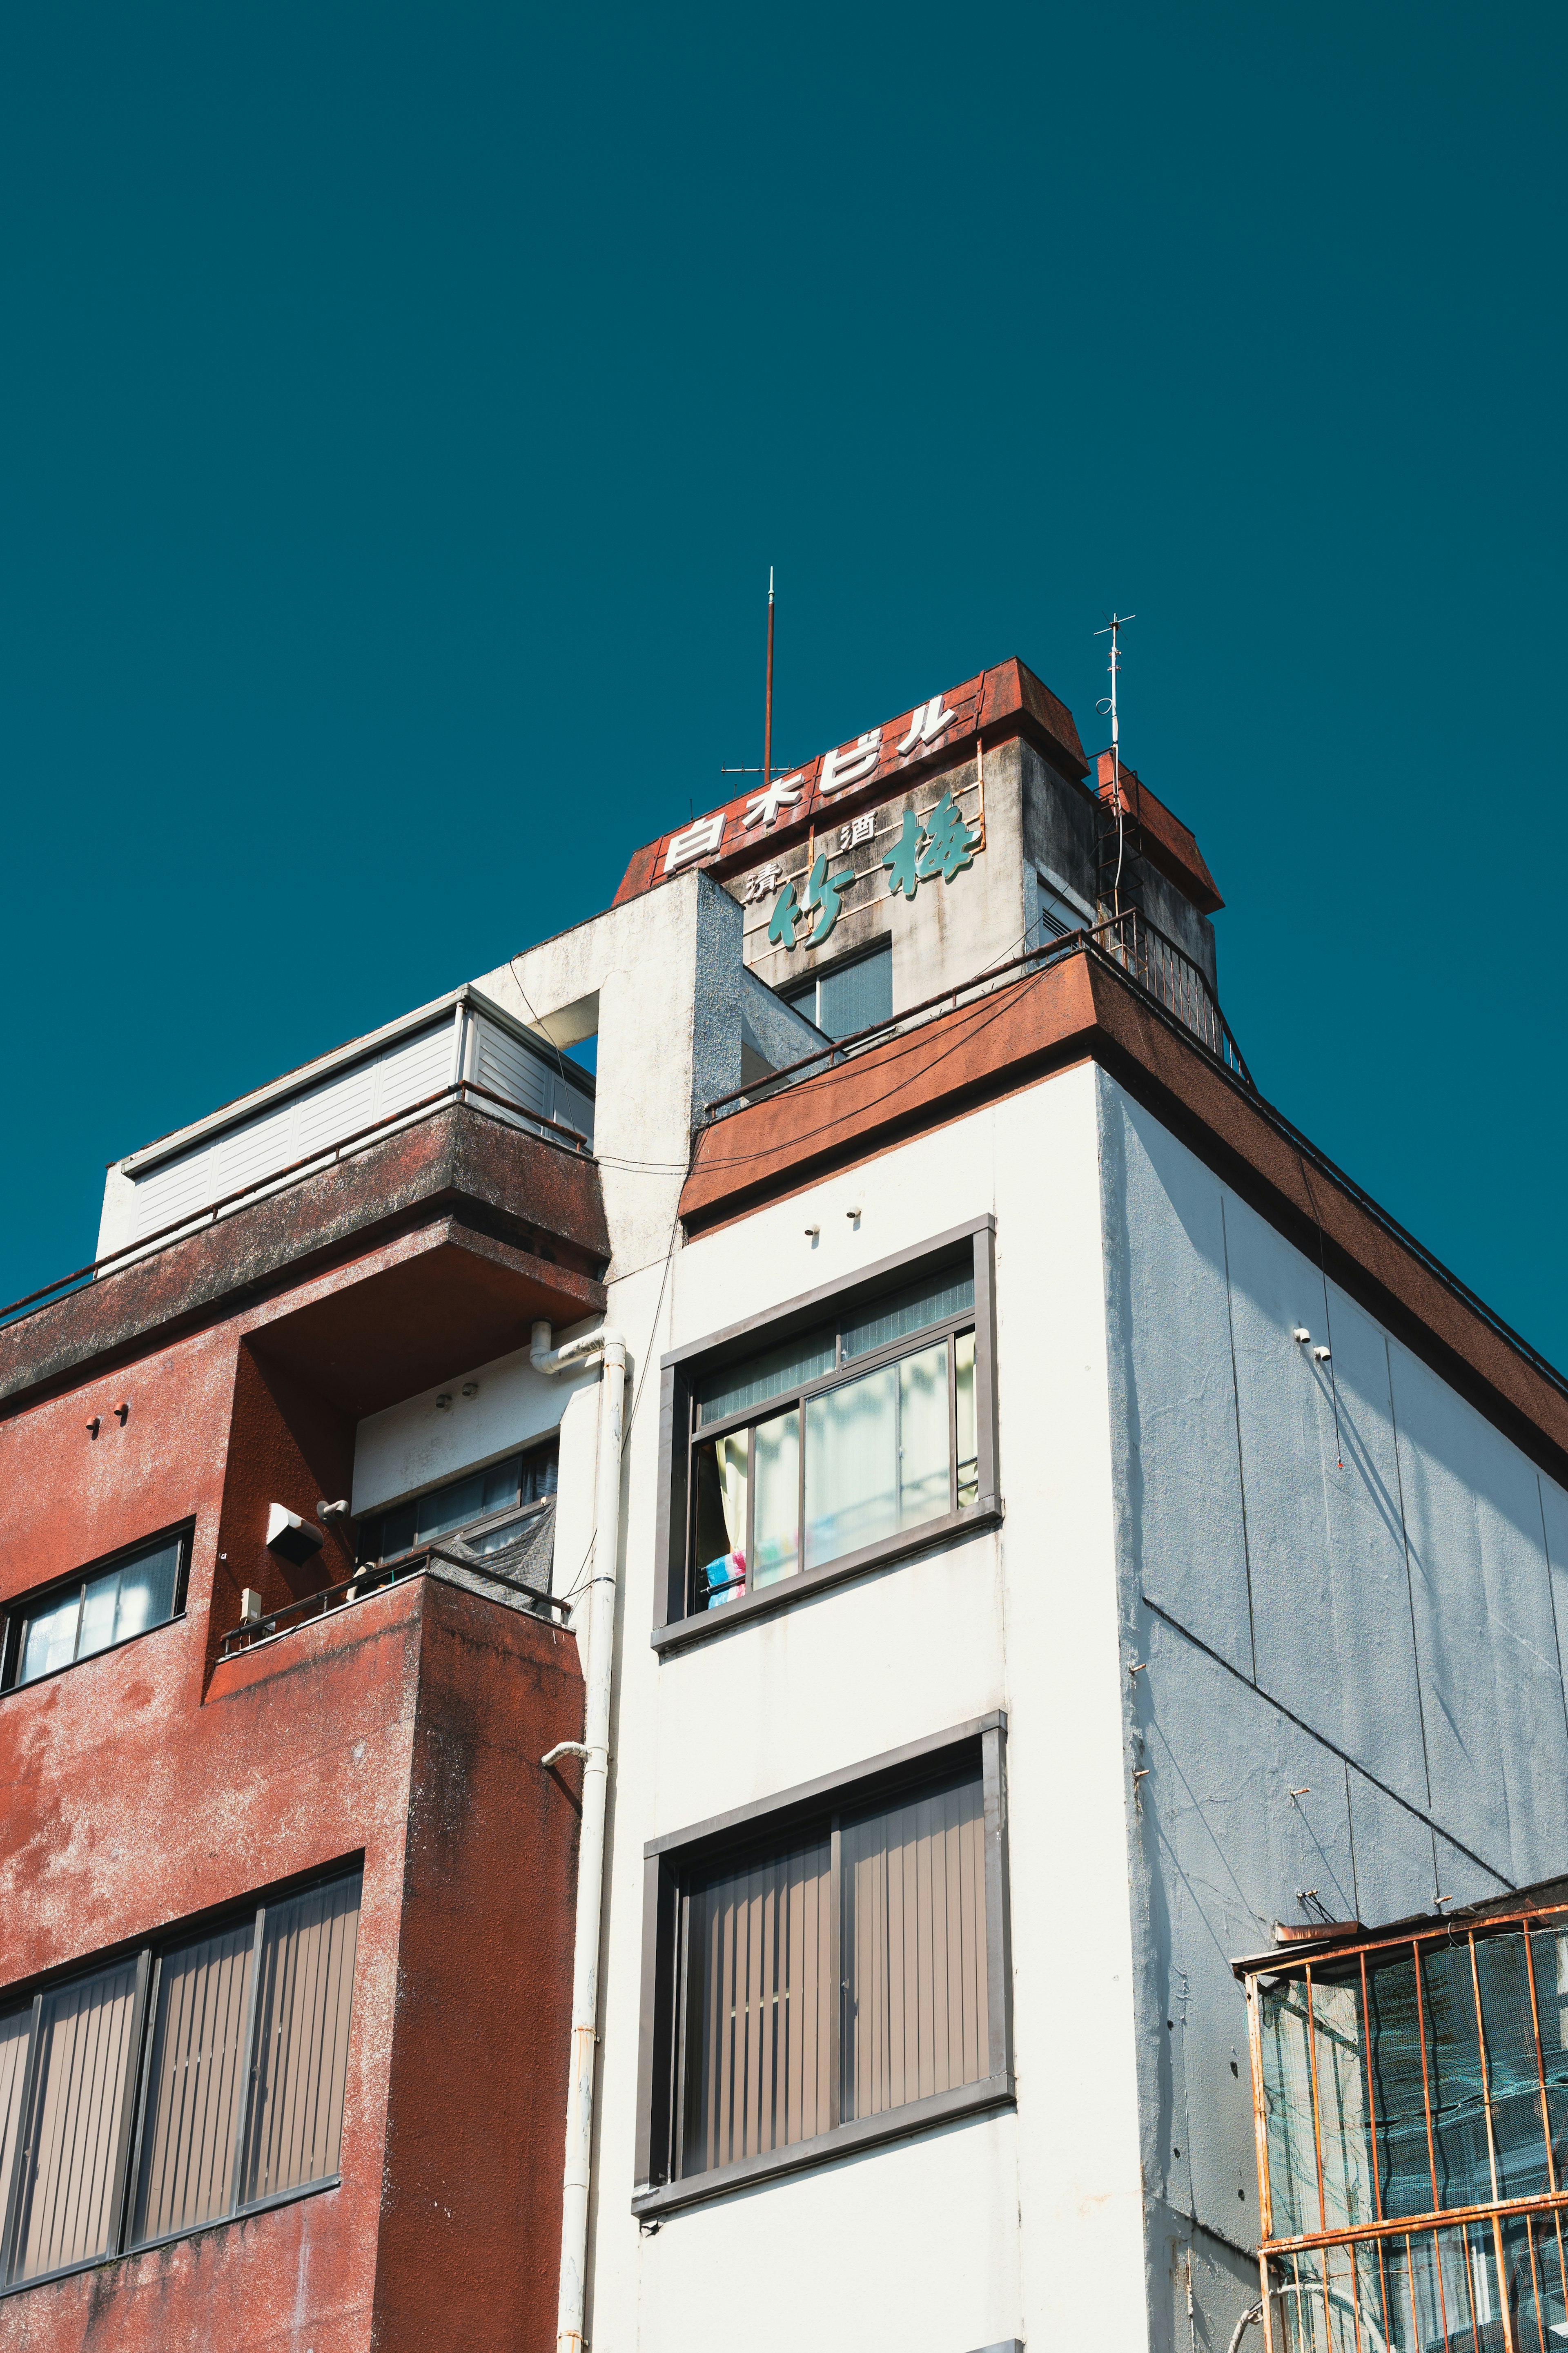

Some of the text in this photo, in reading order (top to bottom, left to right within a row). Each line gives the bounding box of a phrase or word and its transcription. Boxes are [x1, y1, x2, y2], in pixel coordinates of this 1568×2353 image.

[663, 695, 958, 875] 白木ビル
[745, 810, 878, 900] 清酒
